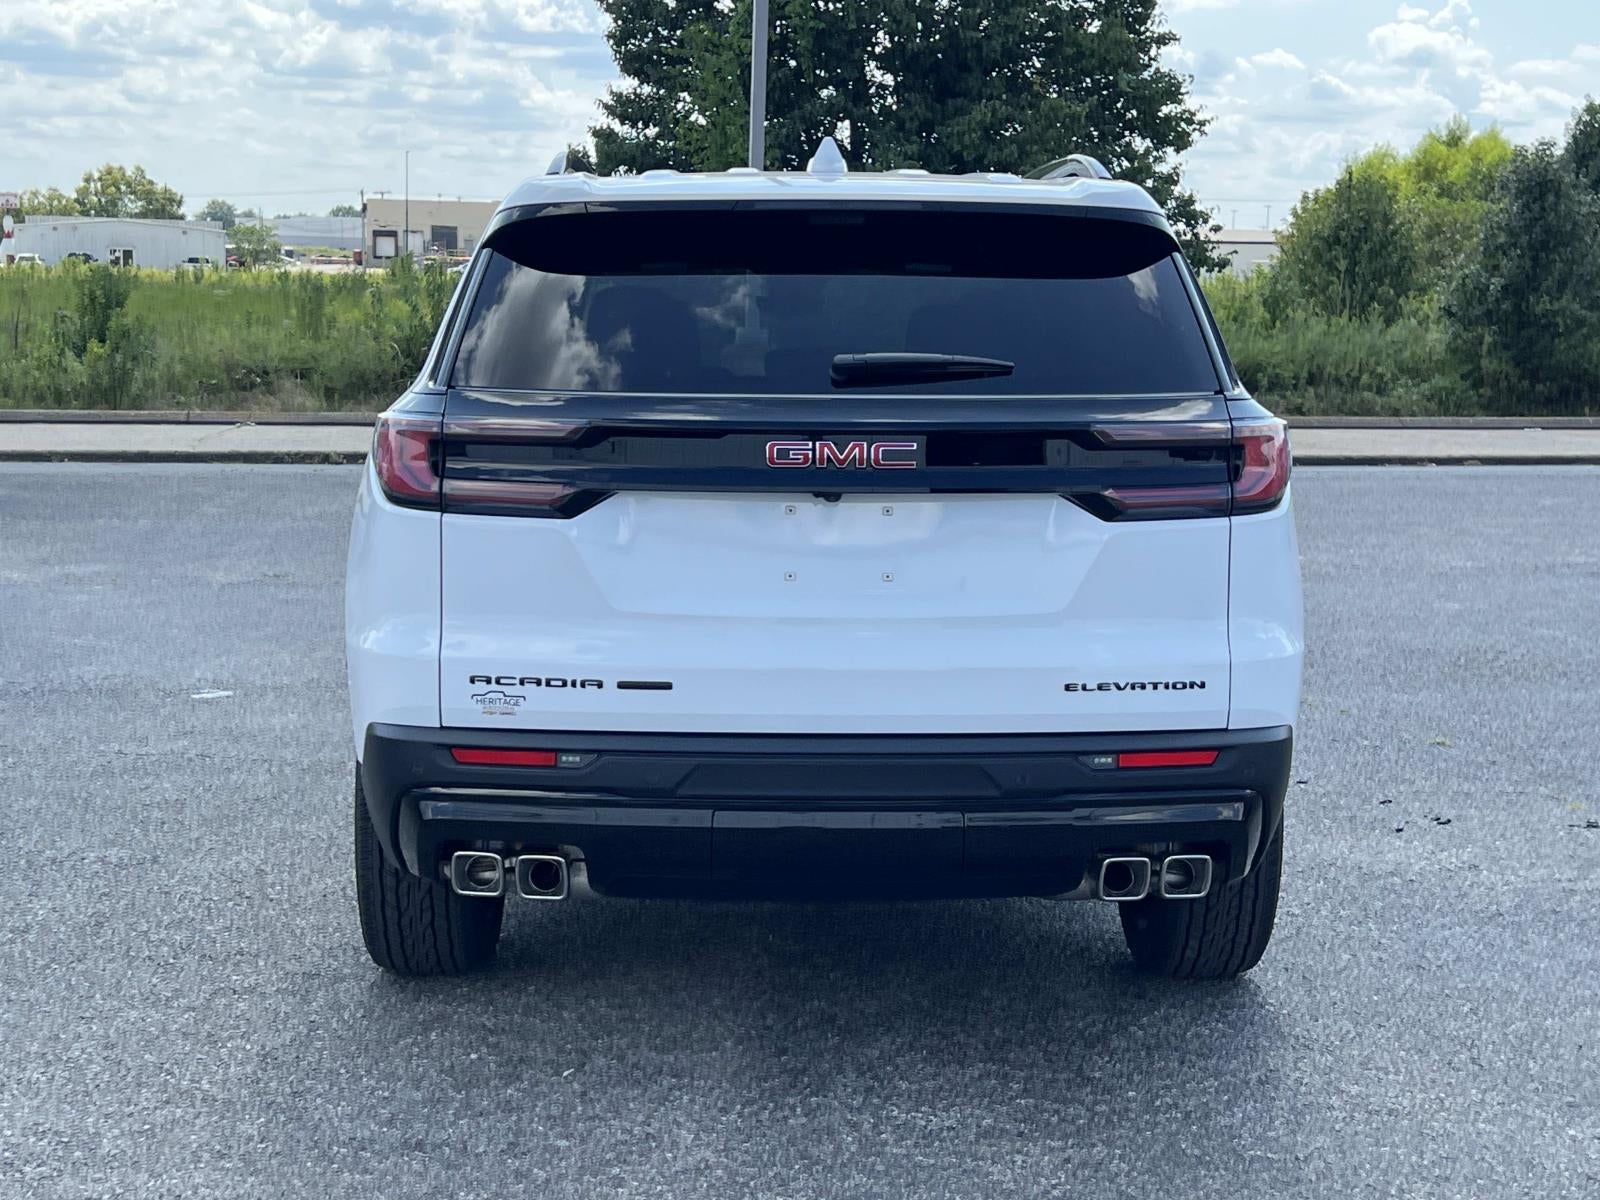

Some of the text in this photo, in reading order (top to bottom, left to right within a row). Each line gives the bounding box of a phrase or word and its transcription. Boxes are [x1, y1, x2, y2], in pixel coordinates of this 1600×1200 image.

[766, 441, 917, 469] GMC
[469, 675, 604, 689] ACADIA
[1064, 681, 1206, 692] ELEVATION
[475, 697, 521, 707] HERITAGE
